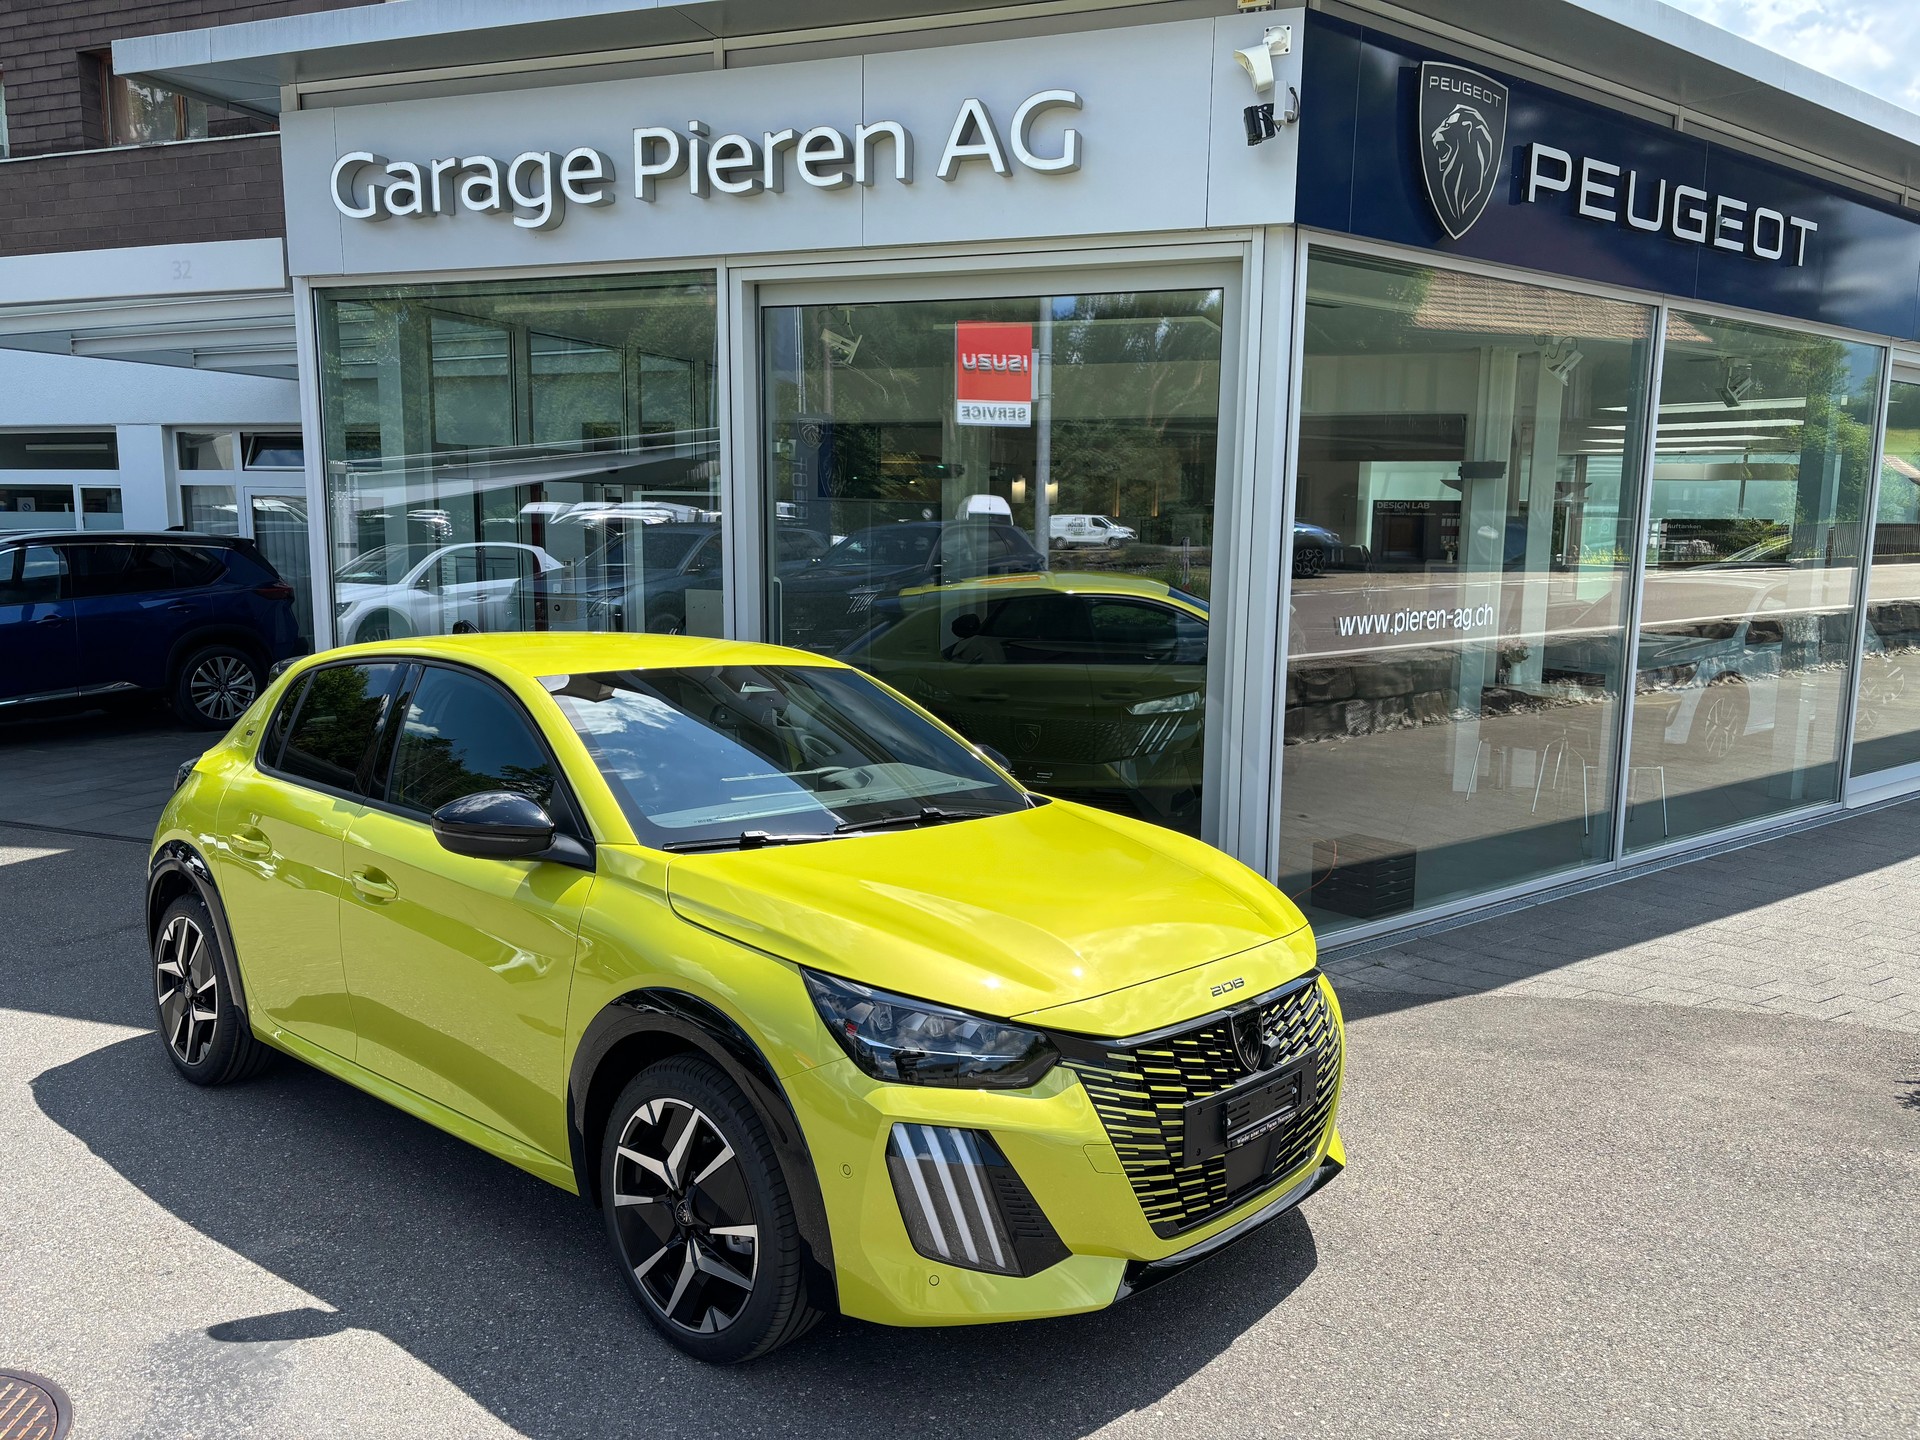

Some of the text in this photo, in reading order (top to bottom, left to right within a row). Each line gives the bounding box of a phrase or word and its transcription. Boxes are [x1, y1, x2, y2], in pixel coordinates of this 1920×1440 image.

[1429, 75, 1502, 108] PEUGEOT
[330, 88, 1081, 231] Garage Pieren AG
[1527, 141, 1819, 267] PEUGEOT
[172, 260, 193, 280] 32
[1376, 501, 1430, 509] DESIGN LAB
[1338, 603, 1494, 637] www.pieren-ag.ch
